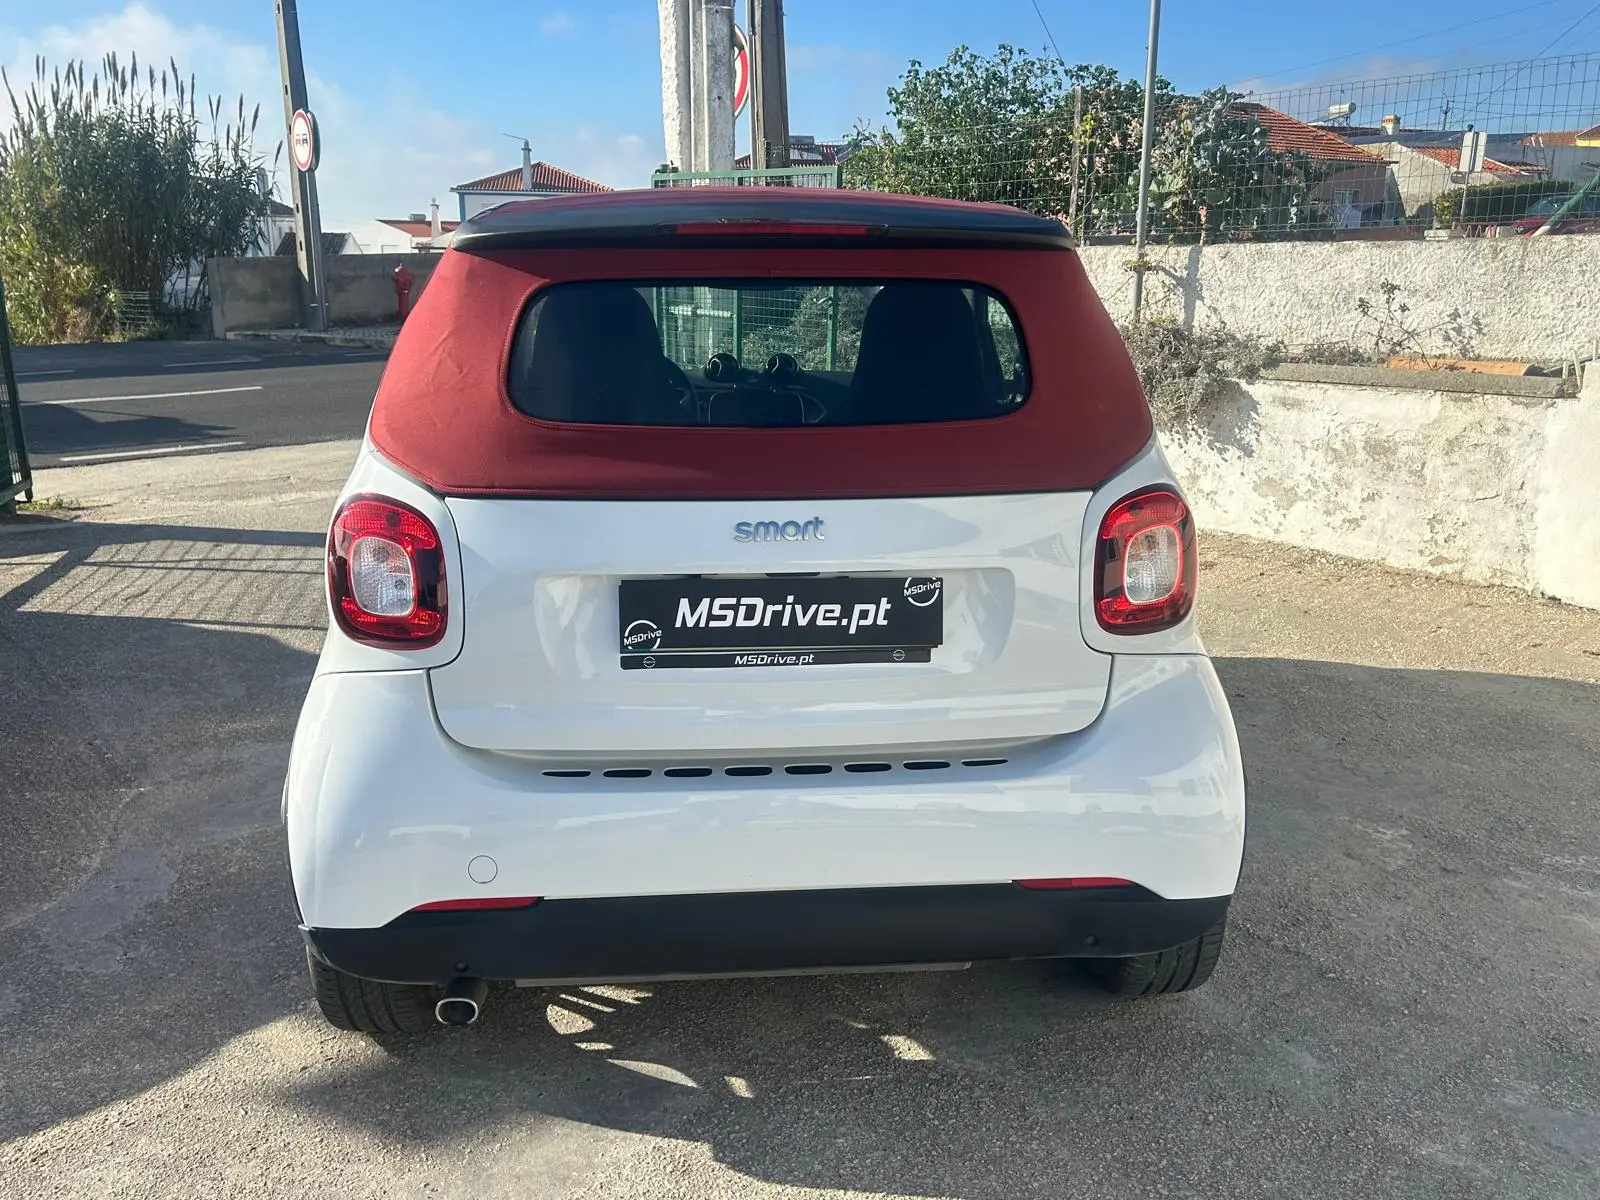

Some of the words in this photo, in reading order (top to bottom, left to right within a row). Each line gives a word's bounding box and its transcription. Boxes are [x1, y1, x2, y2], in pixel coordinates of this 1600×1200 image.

[734, 517, 825, 543] smart
[903, 580, 941, 597] MSDrive
[675, 595, 892, 634] MSDrive.pt
[623, 629, 662, 646] MSDrive
[734, 653, 814, 666] MSDrive.pt
